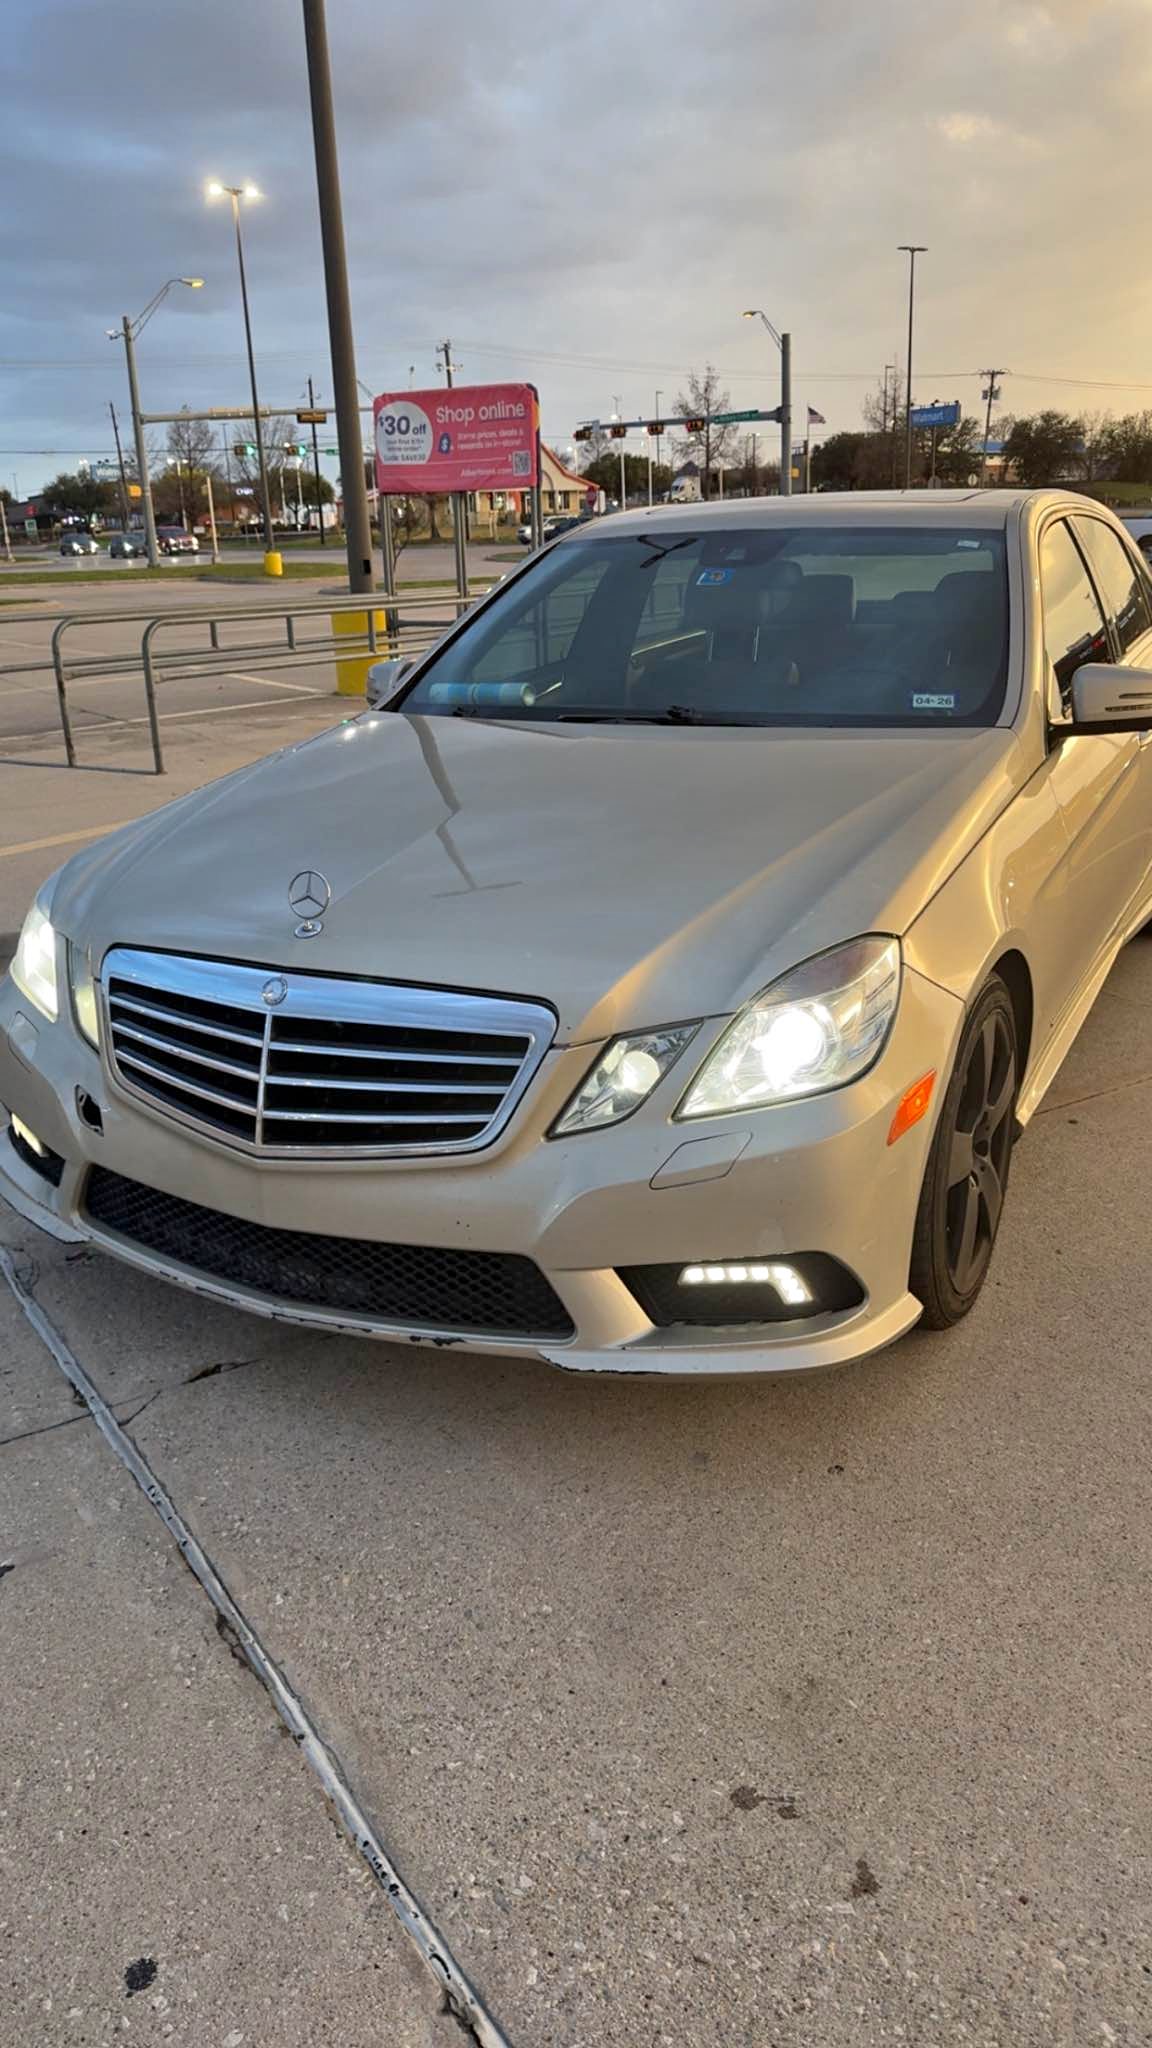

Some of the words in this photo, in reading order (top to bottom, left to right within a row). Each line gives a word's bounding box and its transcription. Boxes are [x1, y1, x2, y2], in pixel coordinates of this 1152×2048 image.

[379, 415, 410, 436] $30
[412, 424, 426, 435] off
[436, 405, 475, 427] Shop
[479, 401, 525, 421] online
